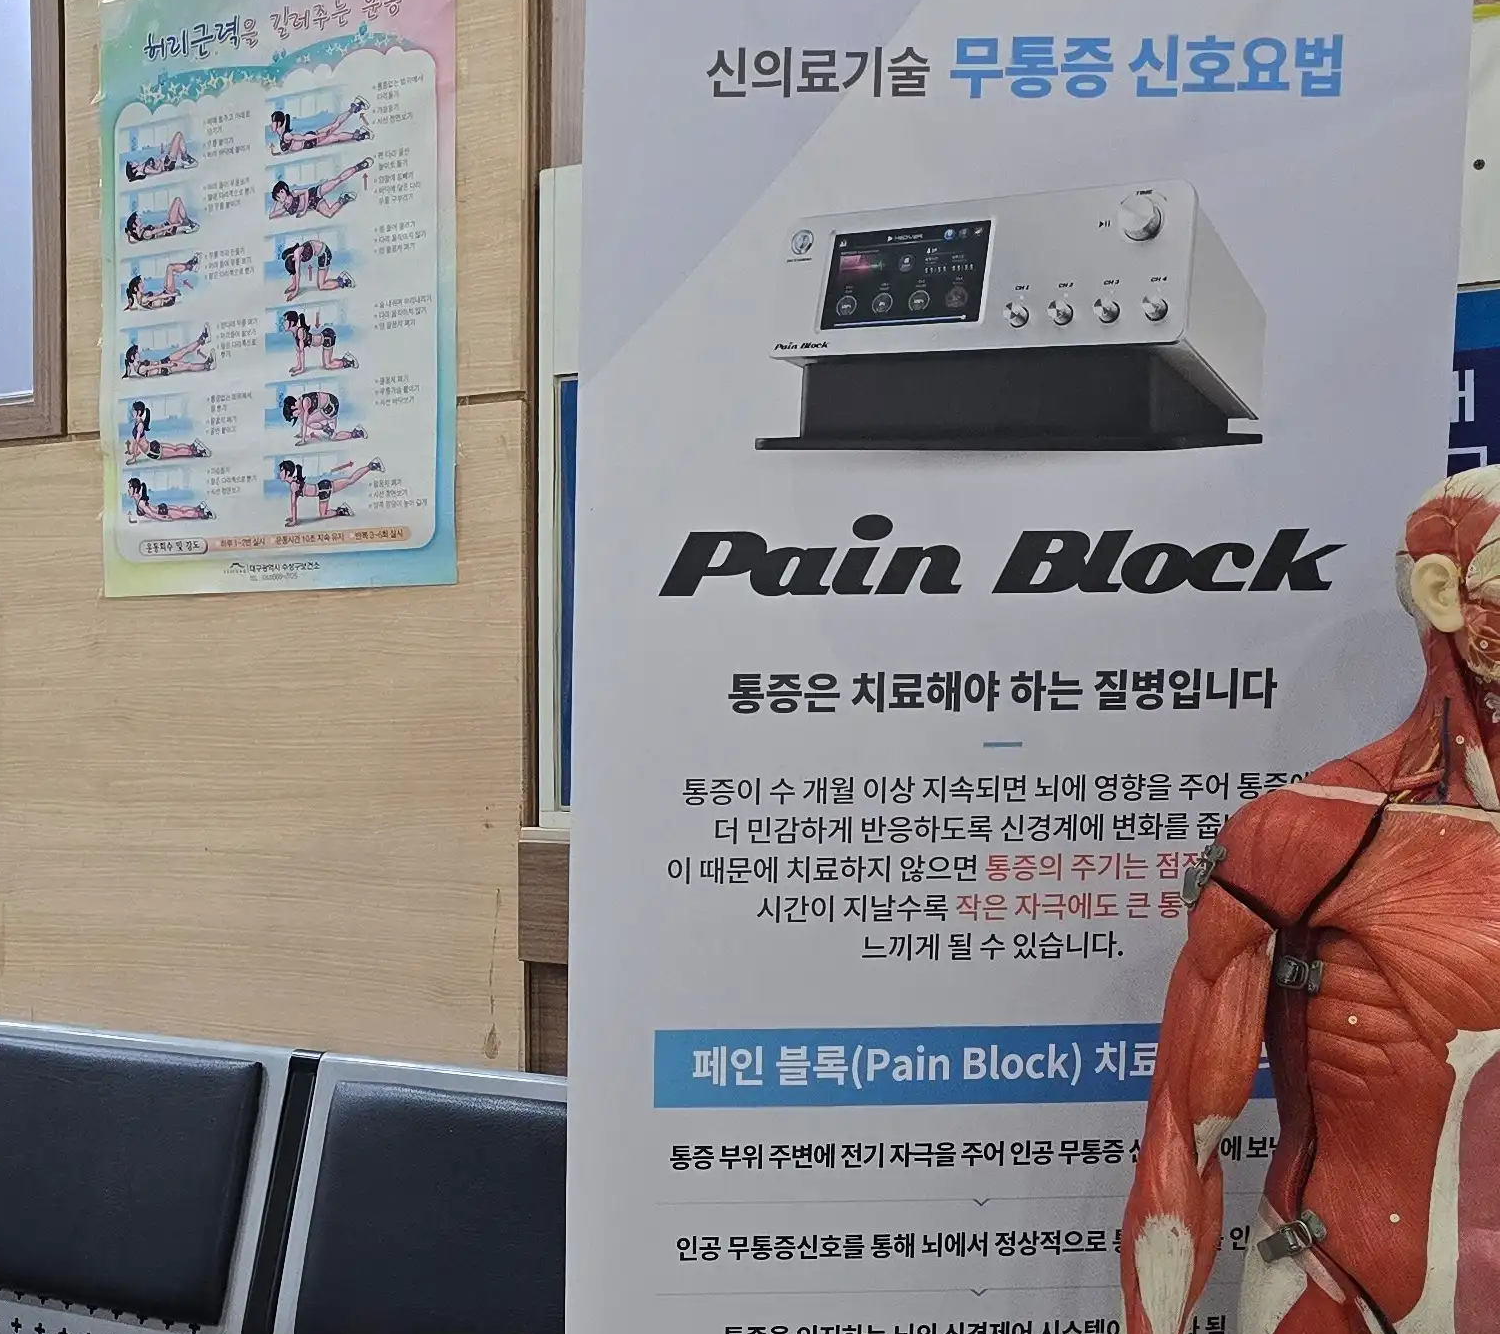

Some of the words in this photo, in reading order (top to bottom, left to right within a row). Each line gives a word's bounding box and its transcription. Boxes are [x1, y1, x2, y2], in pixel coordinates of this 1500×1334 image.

[144, 16, 258, 60] 허리근력을
[707, 47, 930, 98] 신의료기술
[950, 37, 1113, 98] 무통증
[1128, 35, 1343, 97] 신호요법
[774, 342, 798, 350] Pain
[800, 341, 830, 349] Block
[659, 515, 962, 596] Pain
[992, 528, 1347, 594] Block
[728, 674, 840, 714] 통증은
[852, 671, 1000, 712] 치료해야
[1011, 670, 1083, 711] 하는
[1094, 668, 1277, 710] 질병입니다
[683, 778, 760, 805] 통증이
[770, 779, 795, 805] 수
[803, 777, 853, 804] 개월
[864, 776, 915, 804] 이상
[923, 775, 1025, 803] 지속되면
[1035, 775, 1085, 802] 뇌에
[1095, 774, 1171, 801] 영향을
[1179, 773, 1228, 800] 주어
[715, 817, 737, 844] 더
[749, 817, 852, 844] 민감하게
[862, 816, 992, 843] 반응하도록
[1001, 814, 1103, 841] 신경계에
[1113, 813, 1189, 840] 변화를
[668, 857, 690, 884] 이
[701, 857, 778, 884] 때문에
[787, 856, 890, 883] 치료하지
[901, 855, 976, 882] 않으면
[986, 853, 1061, 881] 통증의
[1071, 853, 1148, 880] 주기는
[757, 895, 833, 923] 시간이
[844, 895, 948, 922] 지날수록
[957, 894, 1007, 921] 작은
[1015, 893, 1119, 920] 자극에도
[1126, 893, 1150, 918] 큰
[862, 934, 939, 961] 느끼게
[948, 933, 971, 960] 될
[980, 934, 1005, 960] 수
[1014, 931, 1123, 959] 있습니다.
[693, 1046, 762, 1086] 페인
[776, 1045, 949, 1089] 블록(Pain
[964, 1043, 1081, 1086] Block)
[670, 1146, 714, 1170] 통증
[719, 1144, 762, 1169] 부위
[769, 1143, 835, 1169] 주변에
[841, 1143, 883, 1168] 전기
[890, 1142, 956, 1167] 자극을
[961, 1141, 1004, 1166] 주어
[1011, 1140, 1054, 1165] 인공
[1058, 1140, 1124, 1164] 무통증
[677, 1236, 721, 1261] 인공
[728, 1235, 865, 1260] 무통증신호를
[871, 1233, 915, 1258] 통해
[922, 1232, 988, 1257] 뇌에서
[995, 1230, 1106, 1256] 정상적으로
